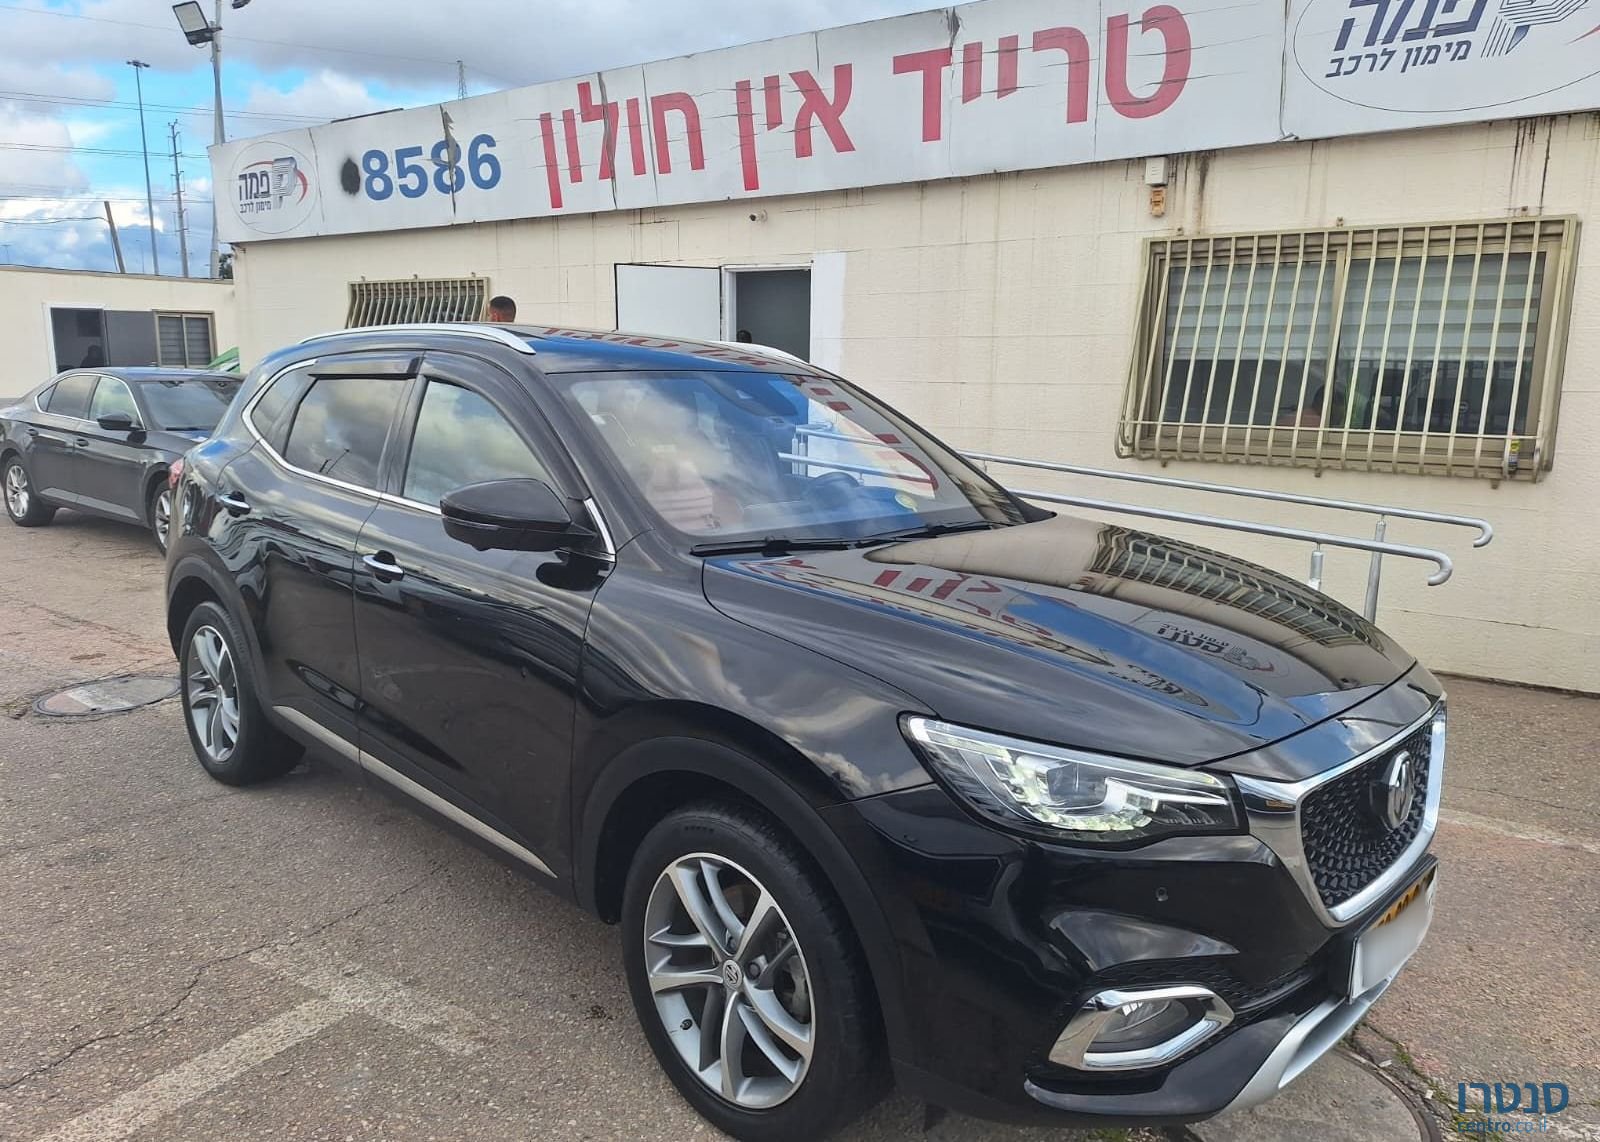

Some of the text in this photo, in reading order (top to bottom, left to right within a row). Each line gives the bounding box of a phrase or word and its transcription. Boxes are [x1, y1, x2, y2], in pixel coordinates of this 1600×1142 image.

[1325, 40, 1472, 79] מימון לרכב
[540, 5, 1191, 209] טרייד אין חולון
[238, 170, 271, 201] פמה
[362, 133, 502, 201] 8586
